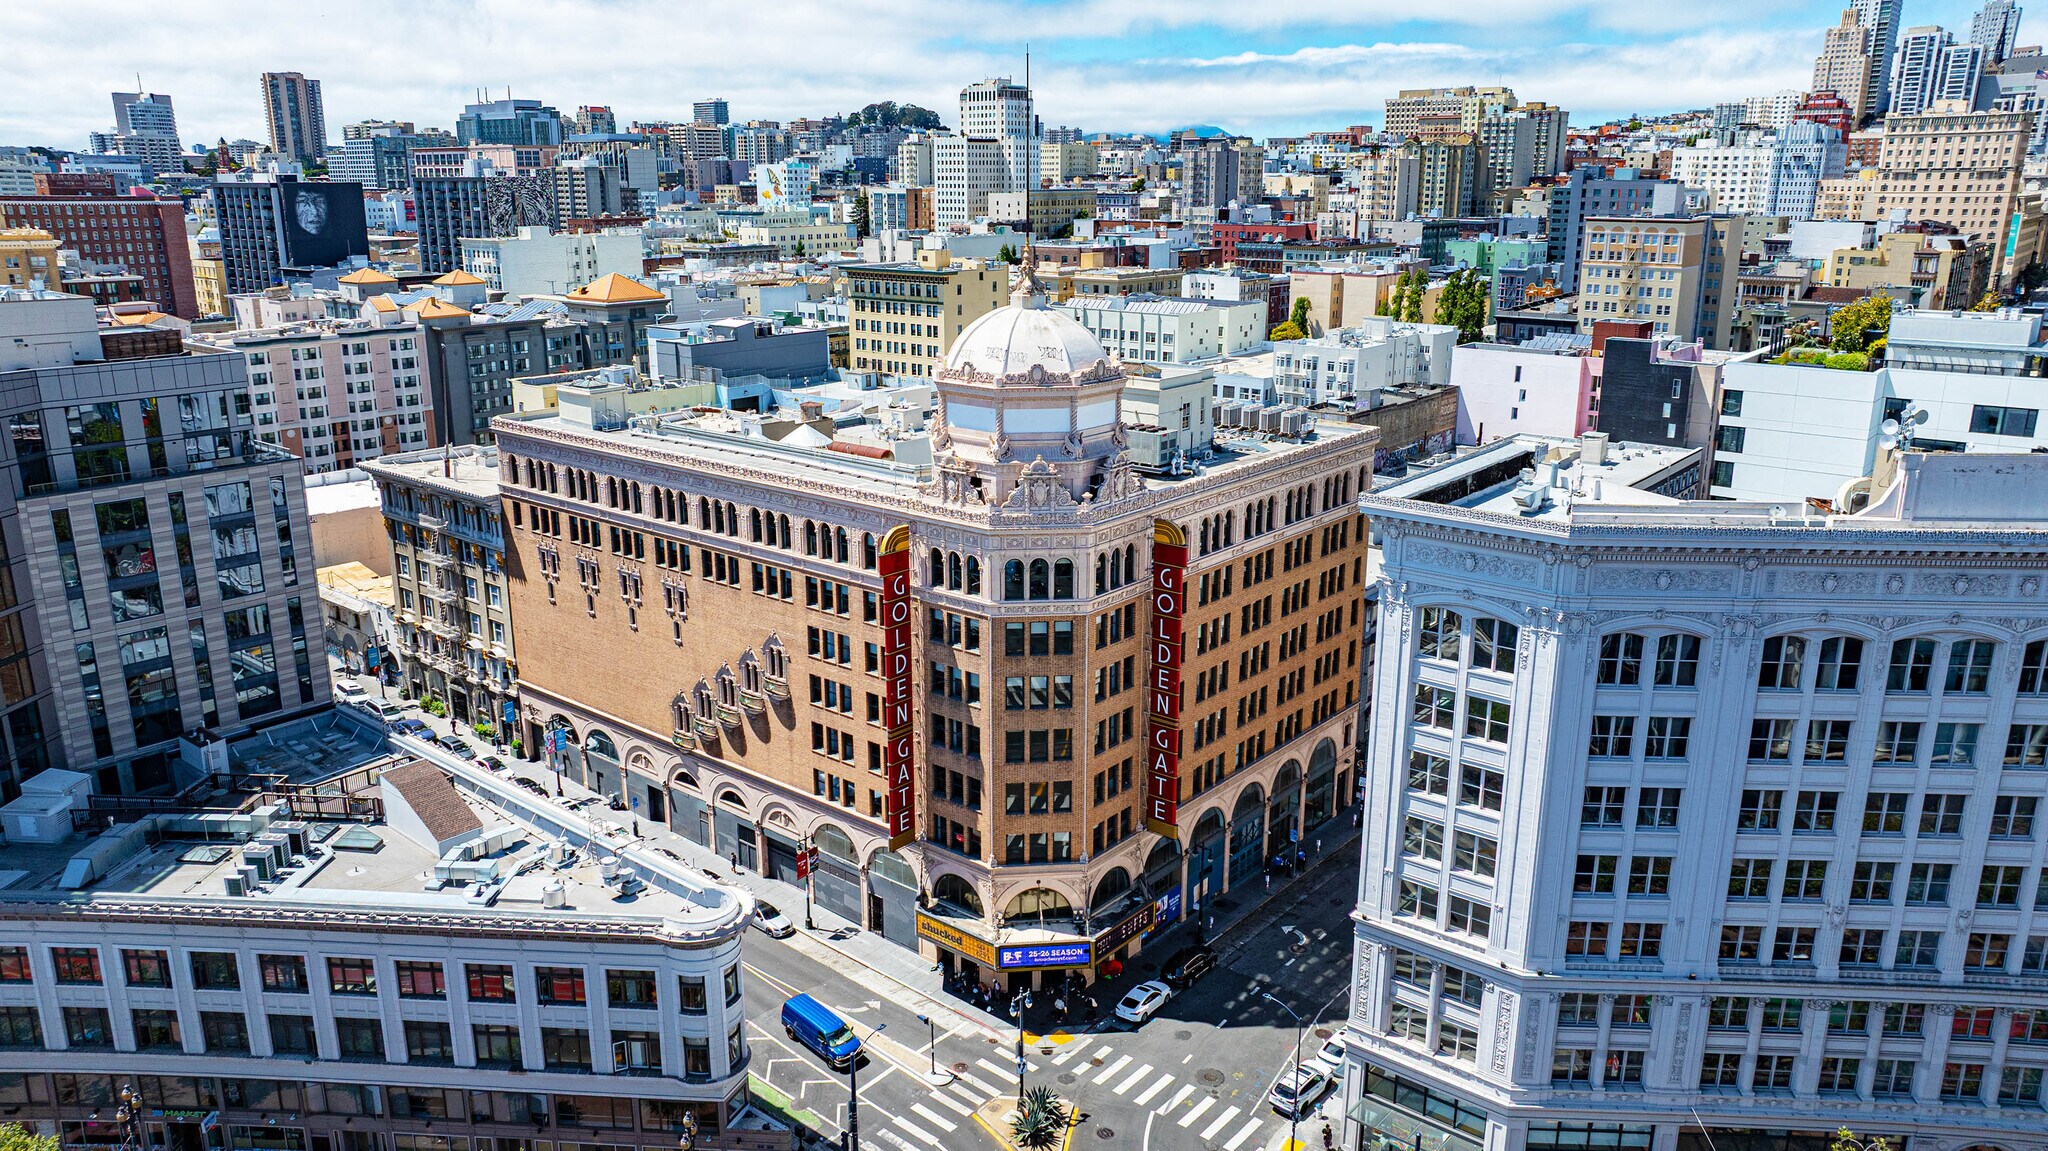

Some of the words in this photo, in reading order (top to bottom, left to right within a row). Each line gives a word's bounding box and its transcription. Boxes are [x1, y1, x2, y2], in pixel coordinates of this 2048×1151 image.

[892, 575, 908, 725] GOLDEN
[1157, 568, 1174, 715] GOLDEN
[897, 738, 910, 832] GATE
[1155, 729, 1168, 821] GATE
[921, 921, 963, 946] shucked
[1028, 950, 1050, 958] 25-26
[1051, 948, 1083, 957] SEASON
[1034, 955, 1077, 963] broadwaysf.com
